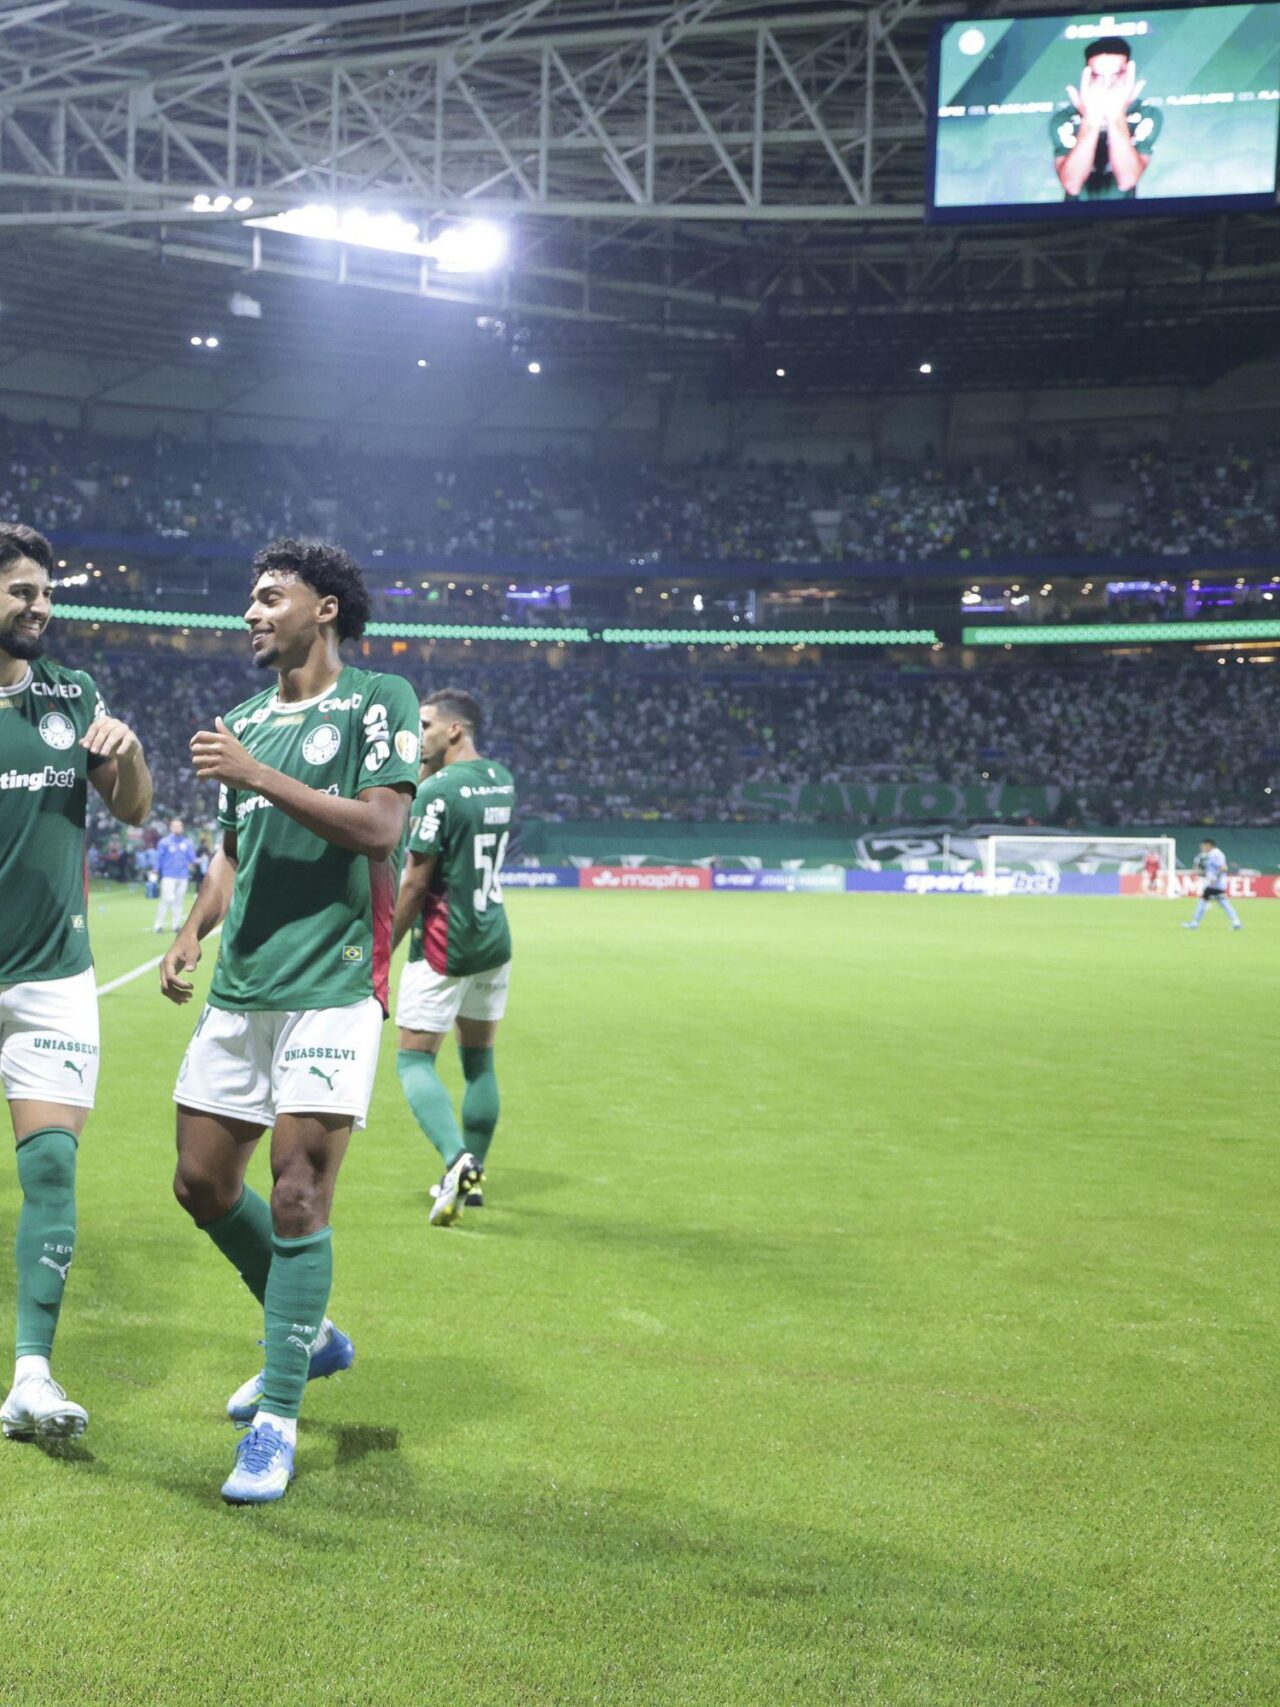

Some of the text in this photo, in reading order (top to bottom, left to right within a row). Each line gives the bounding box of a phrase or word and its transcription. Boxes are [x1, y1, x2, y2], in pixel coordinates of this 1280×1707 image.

[31, 682, 82, 699] CIMED
[622, 865, 700, 889] mapfre
[285, 1047, 356, 1062] UNIASSELVI
